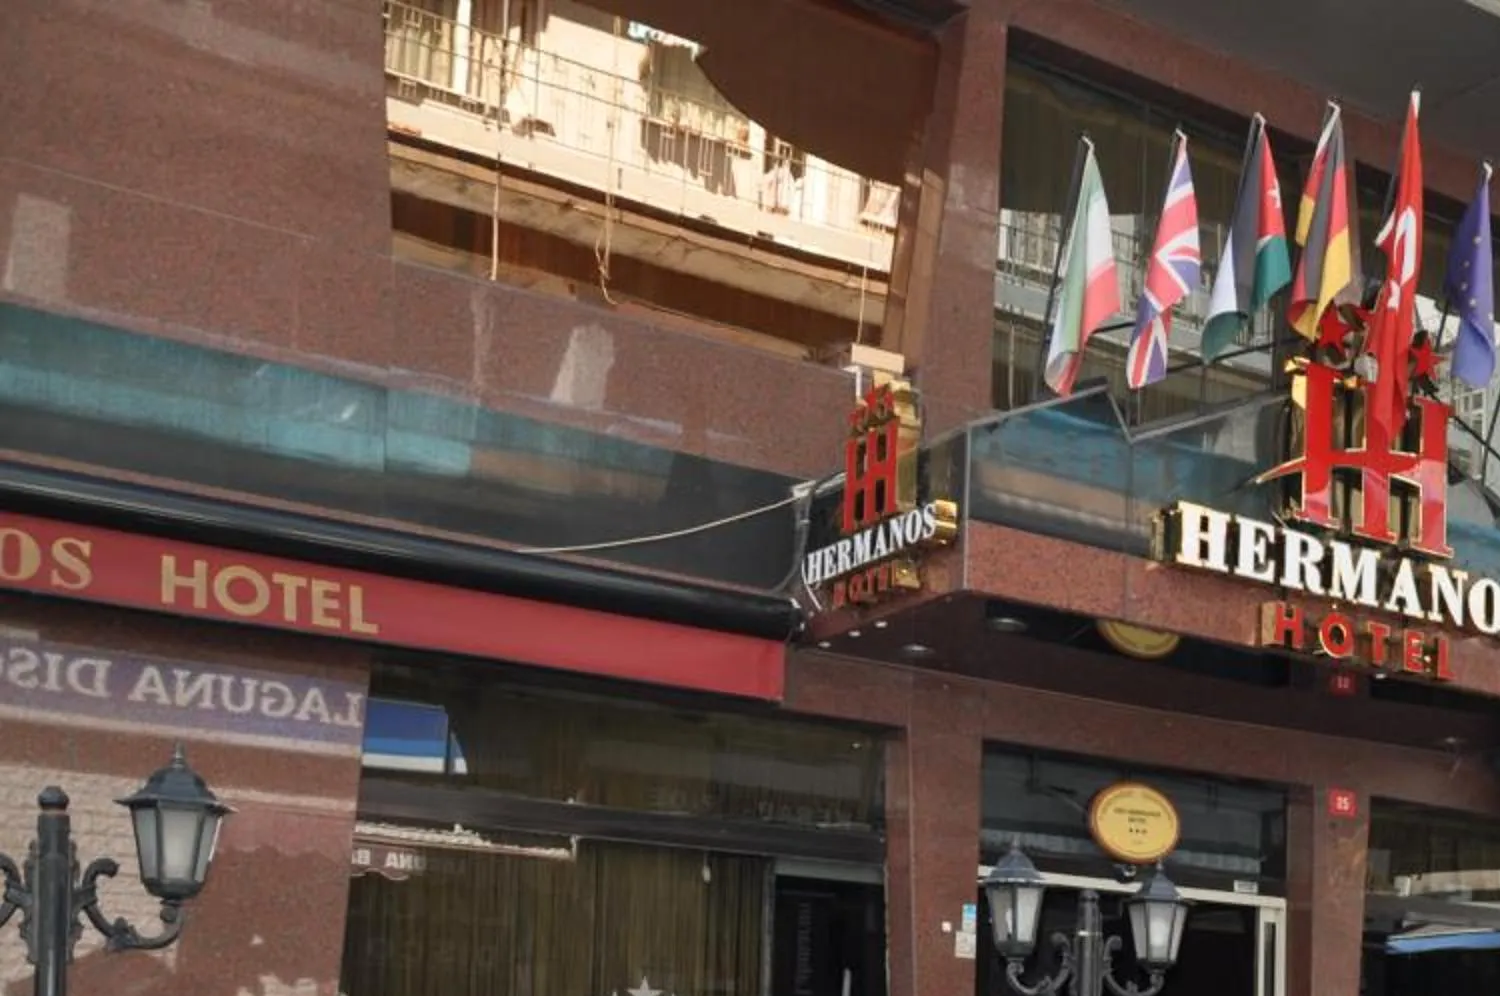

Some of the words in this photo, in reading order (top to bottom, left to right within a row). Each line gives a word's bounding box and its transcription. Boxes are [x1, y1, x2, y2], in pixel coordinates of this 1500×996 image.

[807, 503, 937, 584] HERMANOS
[160, 555, 379, 634] HOTEL
[1274, 602, 1457, 681] HOTEL
